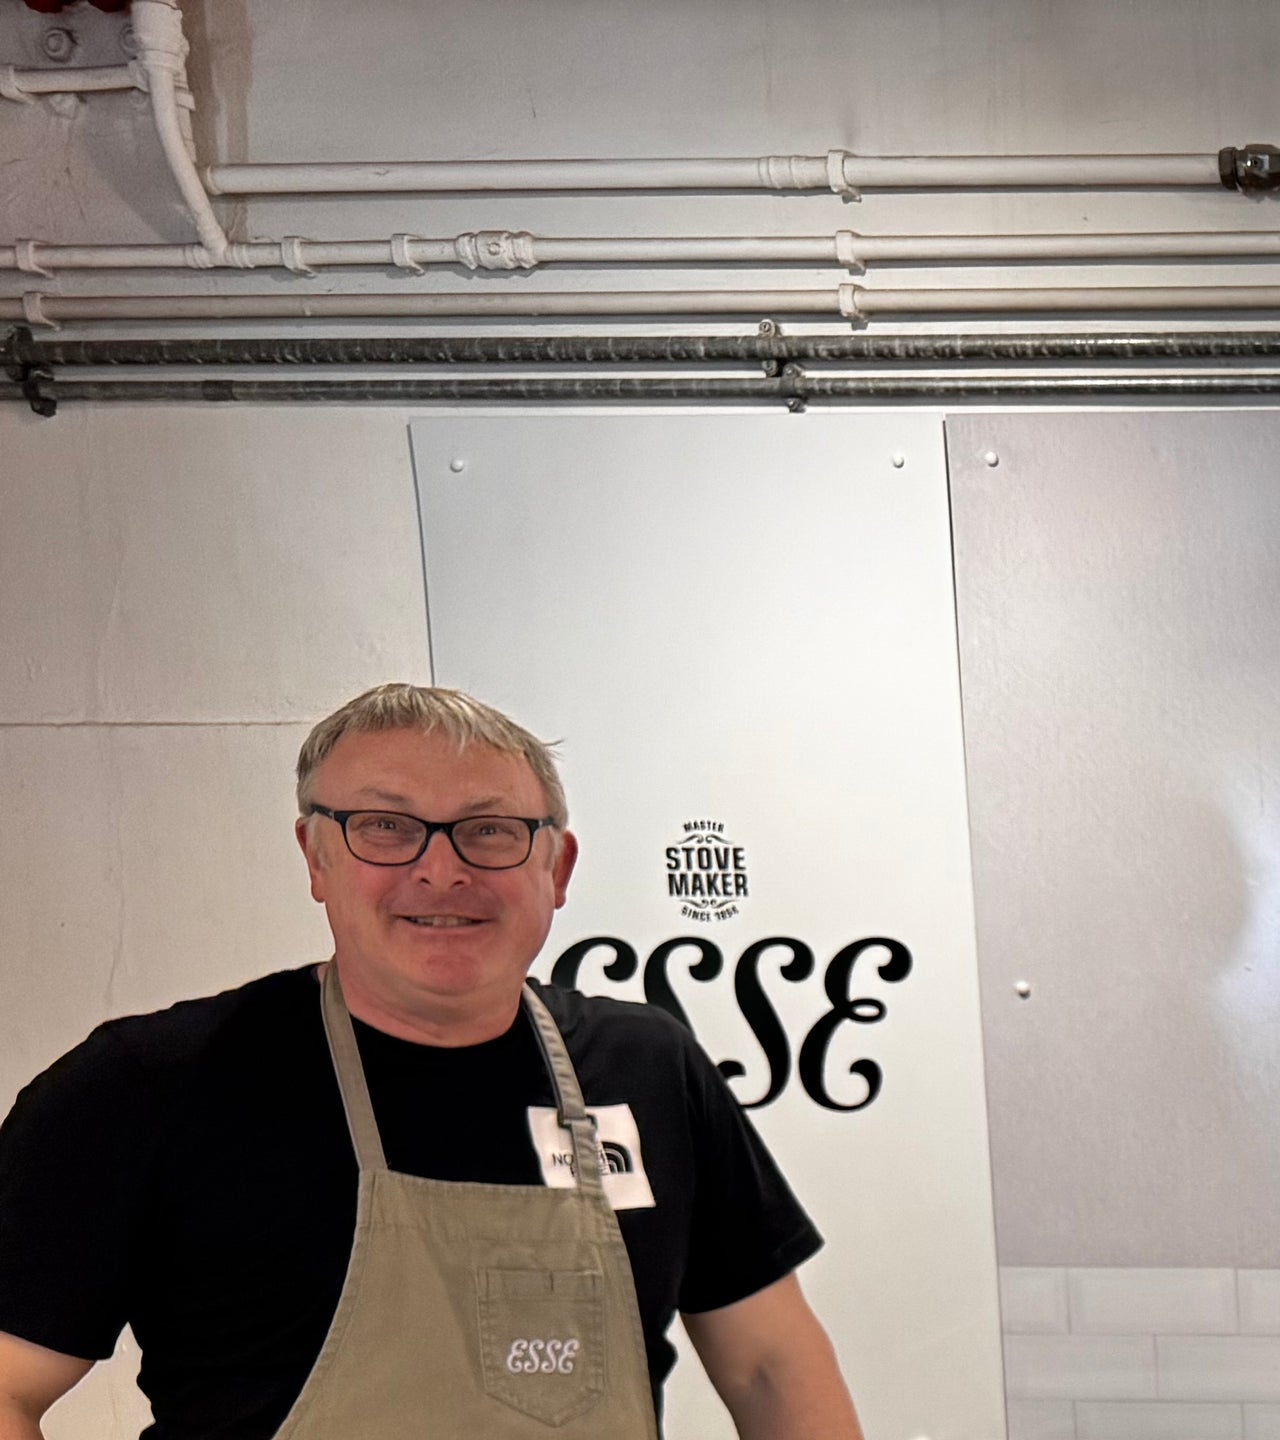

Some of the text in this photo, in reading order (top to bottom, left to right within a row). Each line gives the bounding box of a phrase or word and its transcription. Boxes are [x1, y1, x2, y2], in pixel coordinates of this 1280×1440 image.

[682, 820, 725, 833] MASTER
[665, 847, 746, 871] STOVE
[667, 873, 749, 897] MAKER
[681, 905, 711, 922] SINCE
[506, 1338, 580, 1374] ESSE
